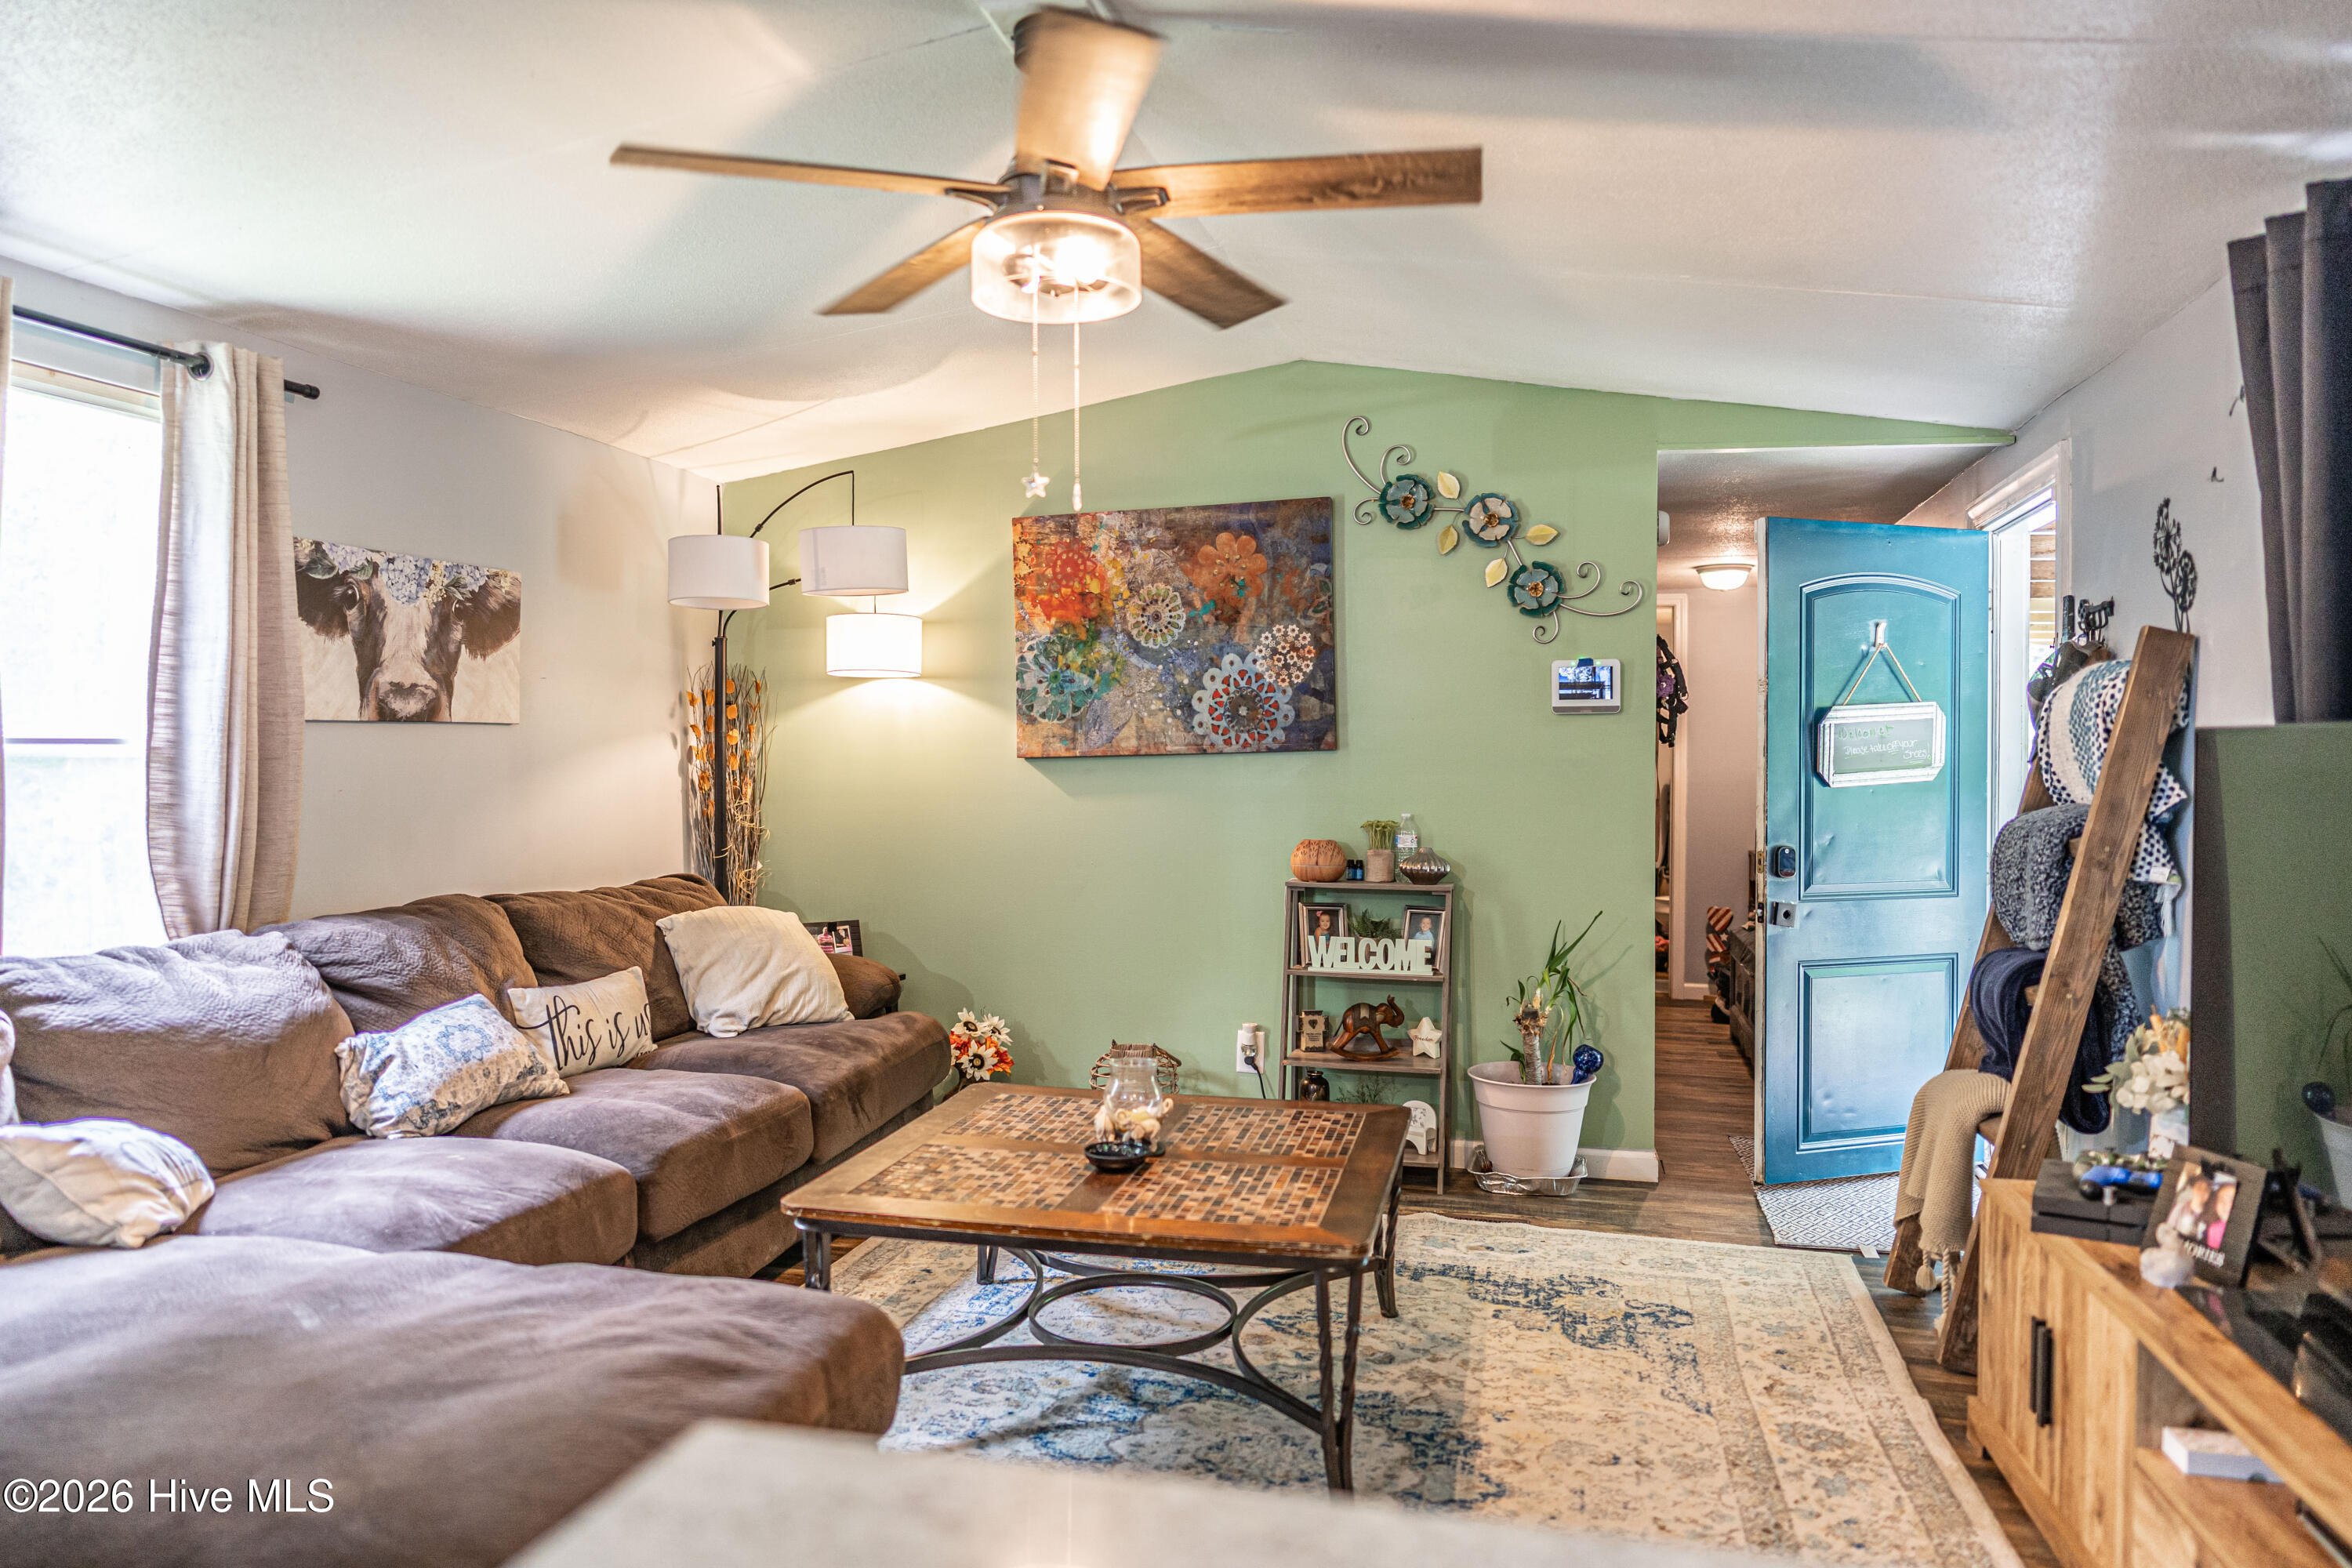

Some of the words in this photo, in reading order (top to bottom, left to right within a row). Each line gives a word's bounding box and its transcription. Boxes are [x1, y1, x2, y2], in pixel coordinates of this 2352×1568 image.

[1844, 746, 1870, 755] Please
[1869, 742, 1886, 753] take
[1308, 935, 1434, 971] WELCOME
[517, 996, 601, 1070] this
[606, 1012, 630, 1058] is
